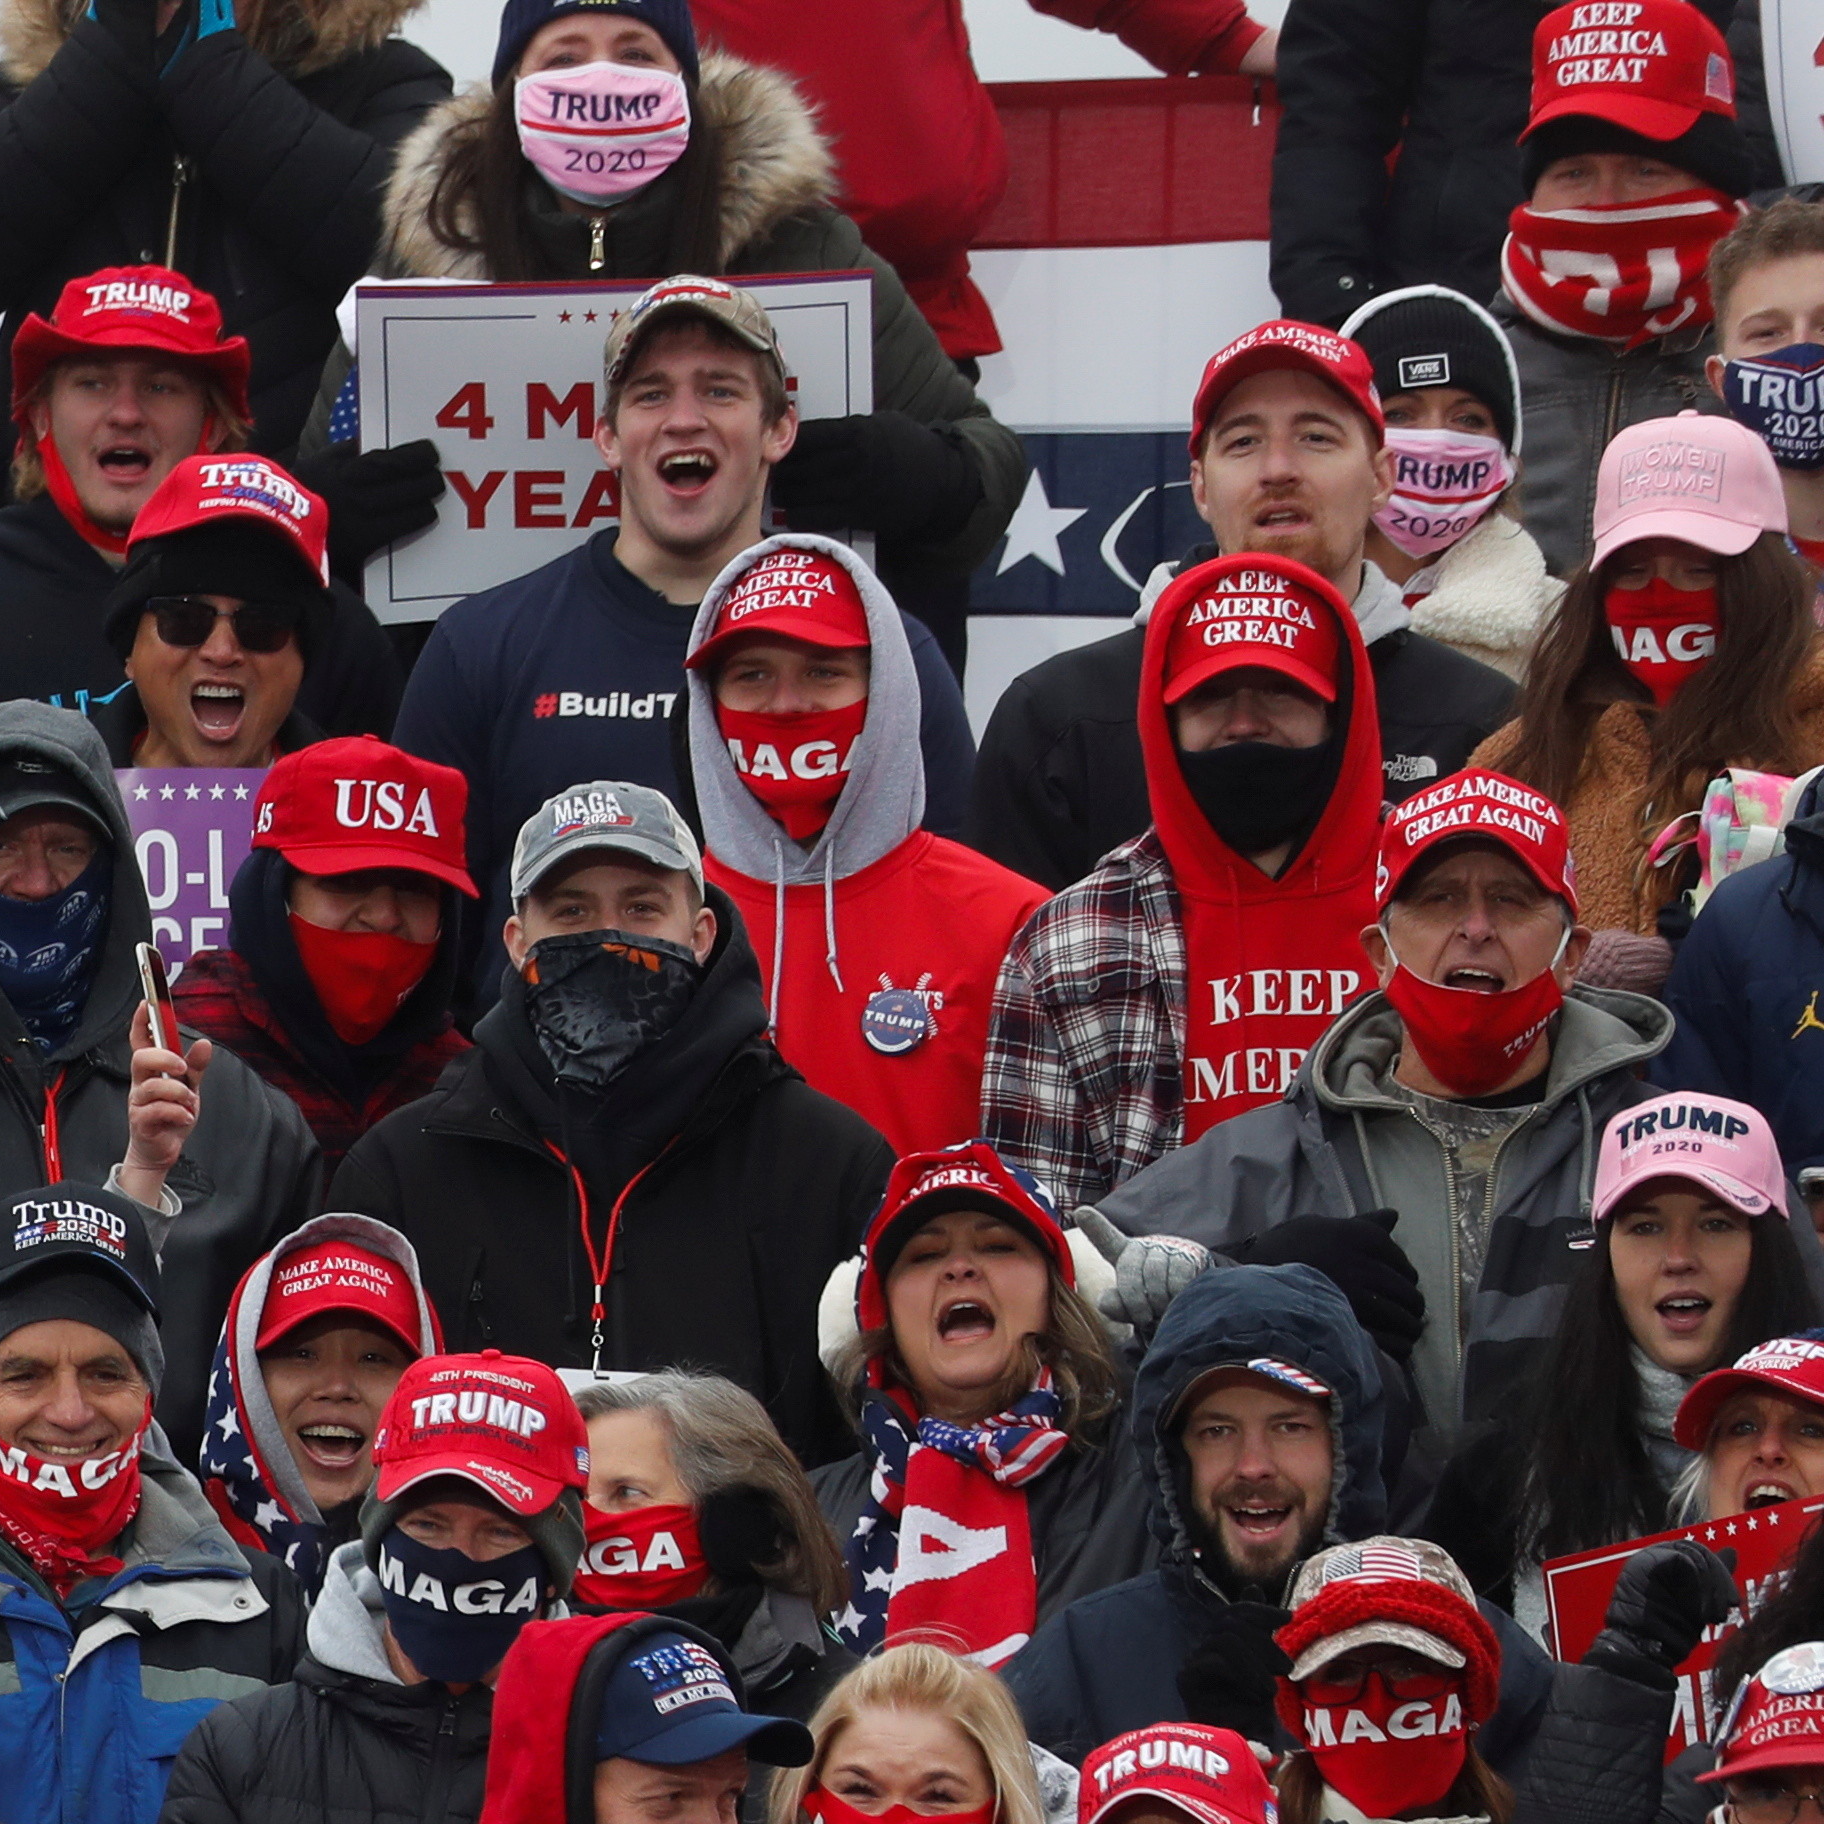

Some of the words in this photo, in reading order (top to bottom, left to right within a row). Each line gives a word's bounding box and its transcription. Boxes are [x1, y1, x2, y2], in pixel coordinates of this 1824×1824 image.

[1569, 4, 1644, 30] KEEP
[1548, 28, 1668, 63] AMERICA
[1555, 56, 1647, 86] GREAT
[548, 91, 661, 122] TRUMP
[565, 148, 646, 174] 2020
[1621, 446, 1719, 475] WOMEN
[199, 464, 311, 520] Trump
[1624, 471, 1714, 495] TRUMP
[1217, 572, 1291, 595] KEEP
[1186, 598, 1316, 630] AMERICA
[1202, 621, 1299, 650] GREAT
[534, 691, 676, 719] #BuildT
[333, 779, 439, 838] USA
[552, 791, 620, 826] MAGA
[1394, 791, 1453, 826] MAKE
[1454, 780, 1559, 826] AMERICA
[582, 811, 617, 825] 2020
[1405, 806, 1475, 845] GREAT
[1477, 806, 1546, 845] AGAIN
[864, 1008, 925, 1028] TRUMP
[1615, 1106, 1751, 1146] TRUMP
[1652, 1140, 1702, 1155] 2020
[13, 1200, 126, 1241] Trump
[54, 1219, 98, 1235] 2020
[15, 1237, 41, 1250] KEEP
[41, 1231, 86, 1248] AMERICA
[89, 1237, 126, 1259] GREAT
[279, 1259, 329, 1285] MAKE
[331, 1256, 394, 1285] AMERICA
[282, 1276, 329, 1298] GREAT
[334, 1273, 388, 1298] AGAIN
[431, 1369, 462, 1386] 45TH
[464, 1372, 535, 1393] PRESIDENT
[411, 1394, 547, 1436] TRUMP
[379, 1555, 538, 1616] MAGA
[1304, 1694, 1462, 1746] MAGA
